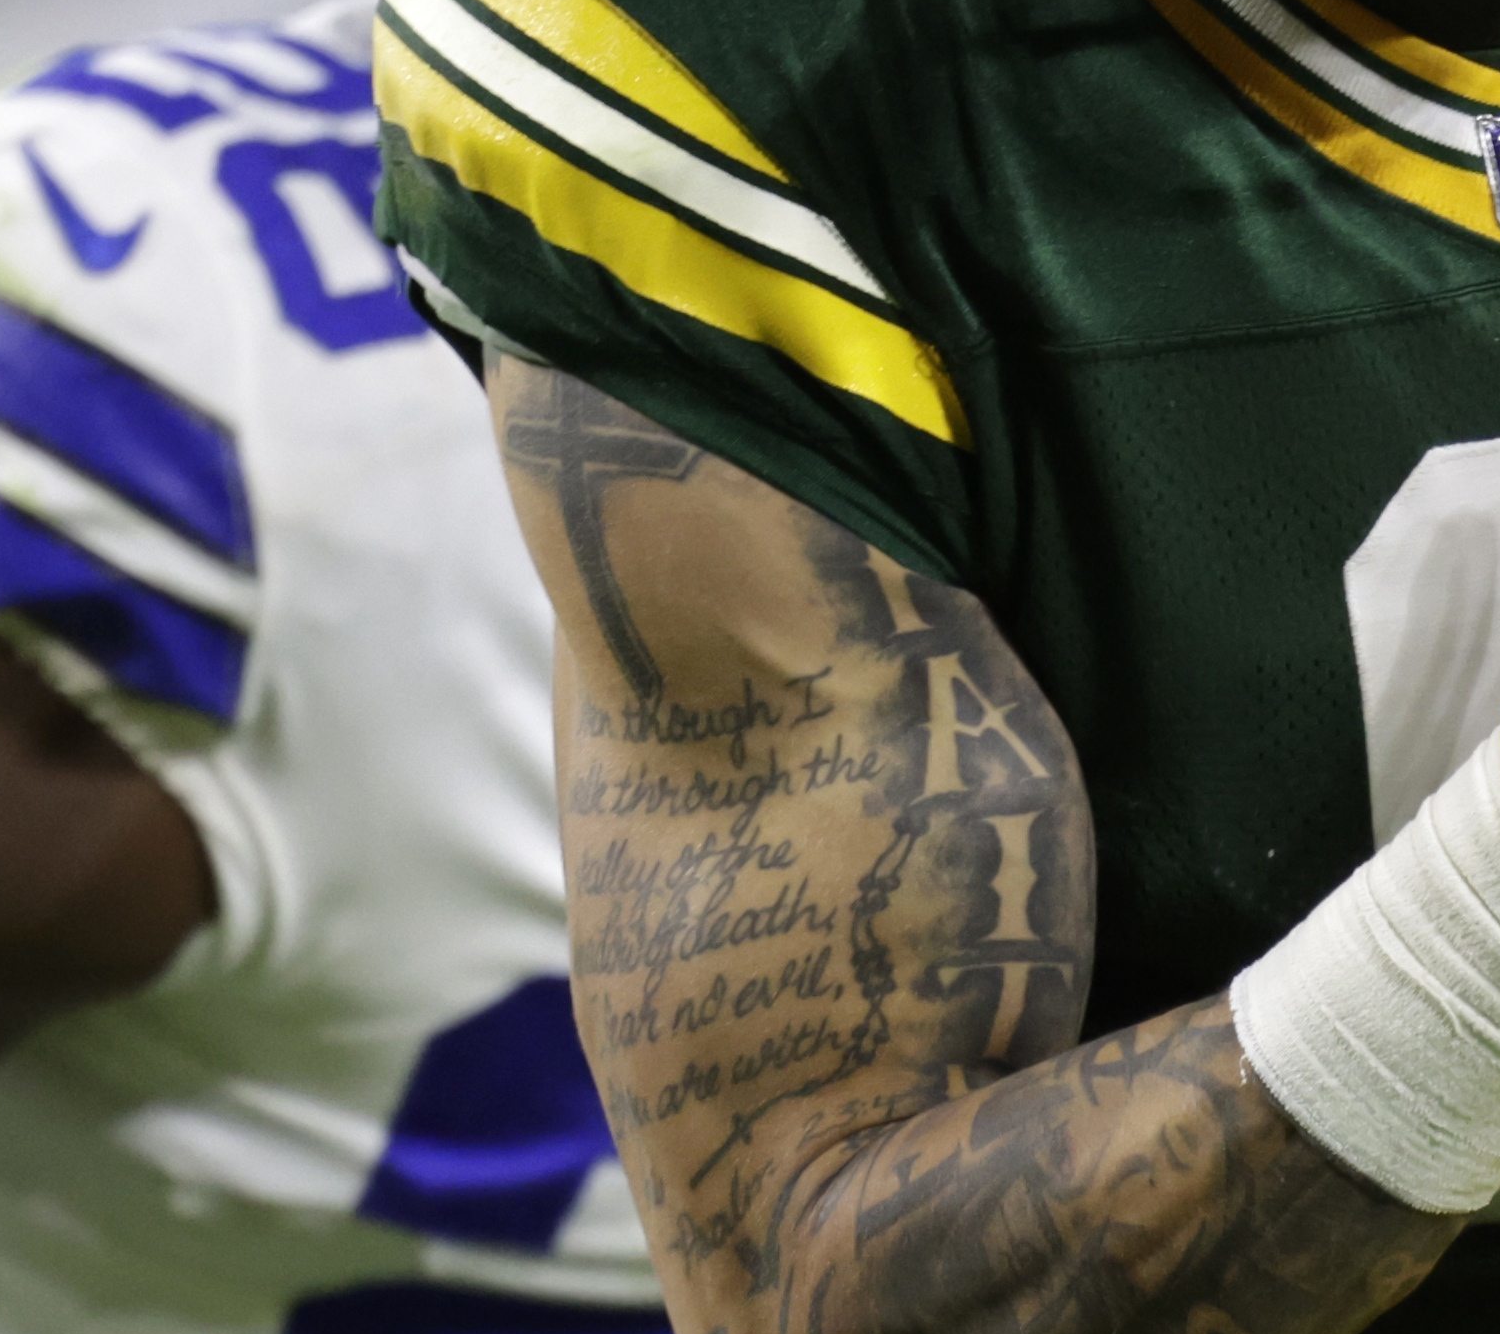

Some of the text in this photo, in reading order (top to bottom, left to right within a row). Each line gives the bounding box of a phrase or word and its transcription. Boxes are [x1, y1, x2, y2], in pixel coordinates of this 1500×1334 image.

[621, 677, 783, 767] though
[787, 665, 835, 729] I
[612, 745, 793, 843] through
[800, 733, 885, 793] the
[679, 873, 838, 962] death,
[672, 973, 728, 1034] no
[733, 944, 845, 1019] evil,
